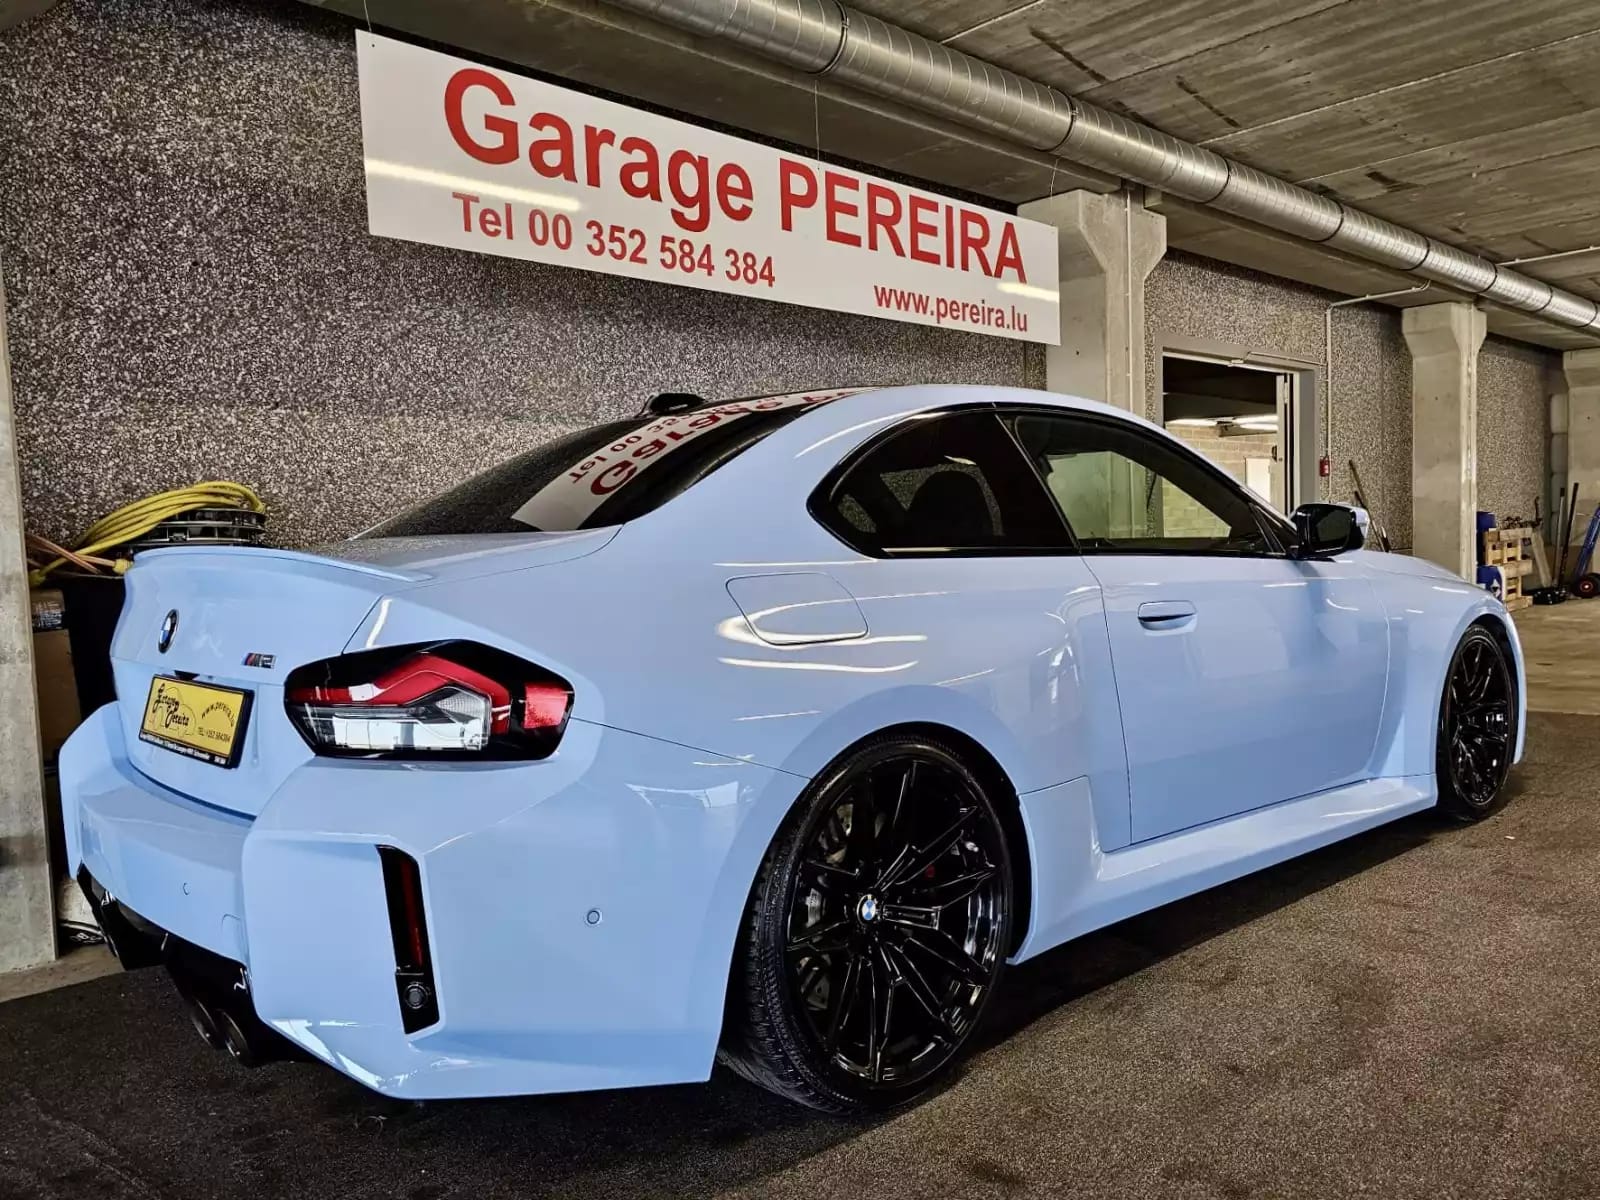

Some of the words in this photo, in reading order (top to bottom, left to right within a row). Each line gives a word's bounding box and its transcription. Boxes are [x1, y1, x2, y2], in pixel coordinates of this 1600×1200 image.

[443, 67, 754, 234] Garage
[778, 157, 1028, 284] PEREIRA
[452, 191, 514, 241] Tel
[527, 208, 573, 251] 00
[585, 219, 648, 266] 352
[659, 234, 716, 278] 584
[725, 248, 776, 288] 384
[873, 284, 1029, 333] www.pereira.lu
